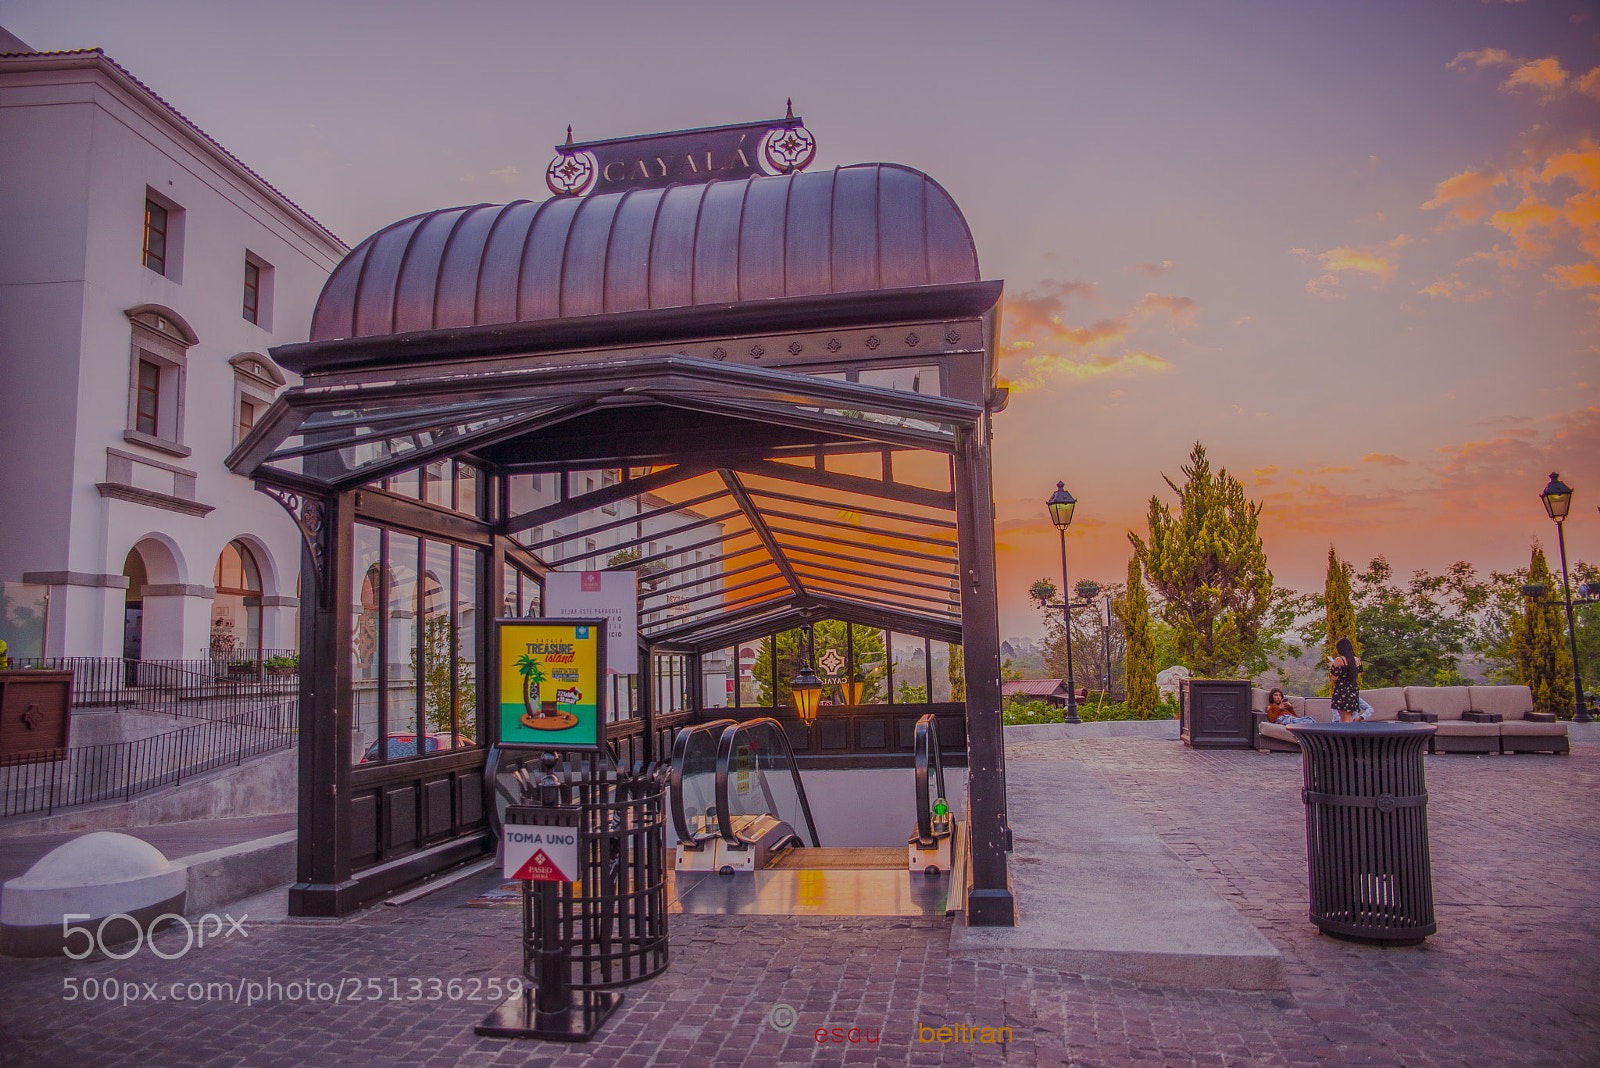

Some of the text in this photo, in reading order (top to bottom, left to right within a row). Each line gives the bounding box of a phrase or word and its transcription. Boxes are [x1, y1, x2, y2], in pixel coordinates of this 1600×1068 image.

[603, 134, 750, 182] CAYALÁ
[526, 643, 574, 654] TREASURE
[545, 651, 576, 664] island
[507, 832, 575, 846] TOMA UNO
[528, 866, 553, 874] PASEO
